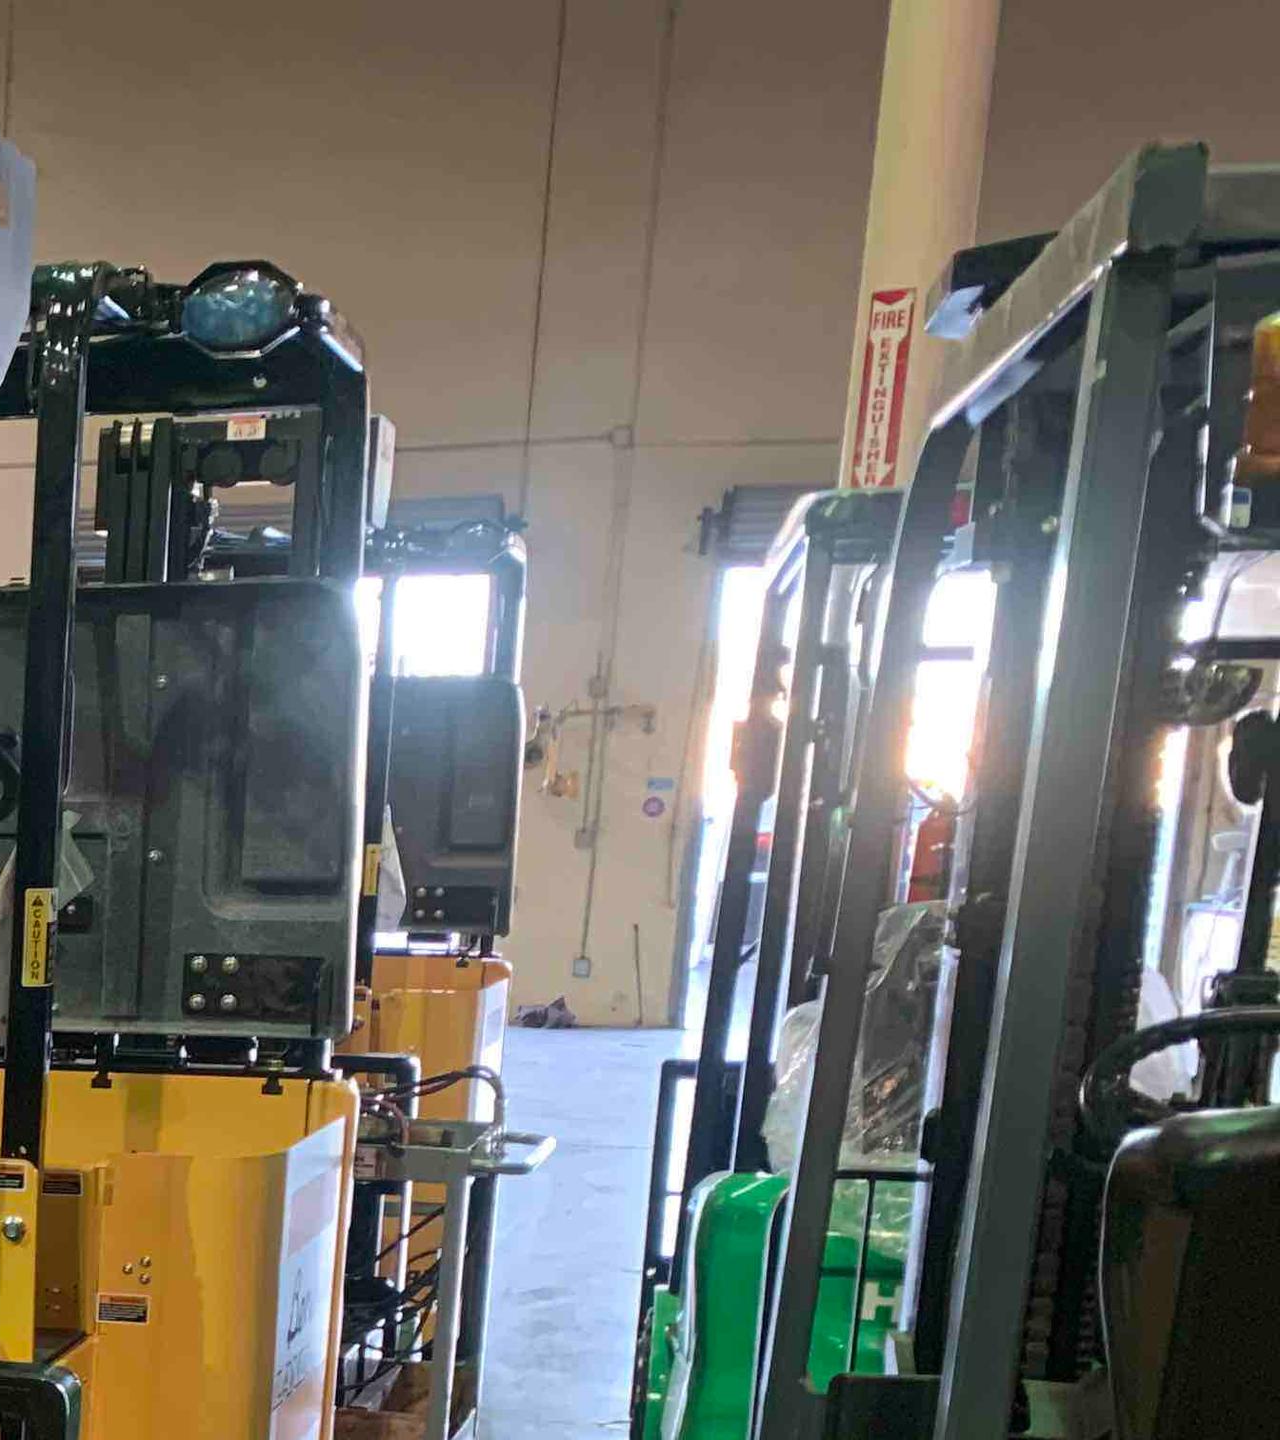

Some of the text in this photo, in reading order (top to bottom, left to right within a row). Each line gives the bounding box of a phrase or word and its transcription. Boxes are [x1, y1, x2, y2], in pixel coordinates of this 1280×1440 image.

[872, 309, 907, 329] FIRE
[864, 338, 892, 485] EXTINGUISHER
[30, 909, 42, 980] CAUTION
